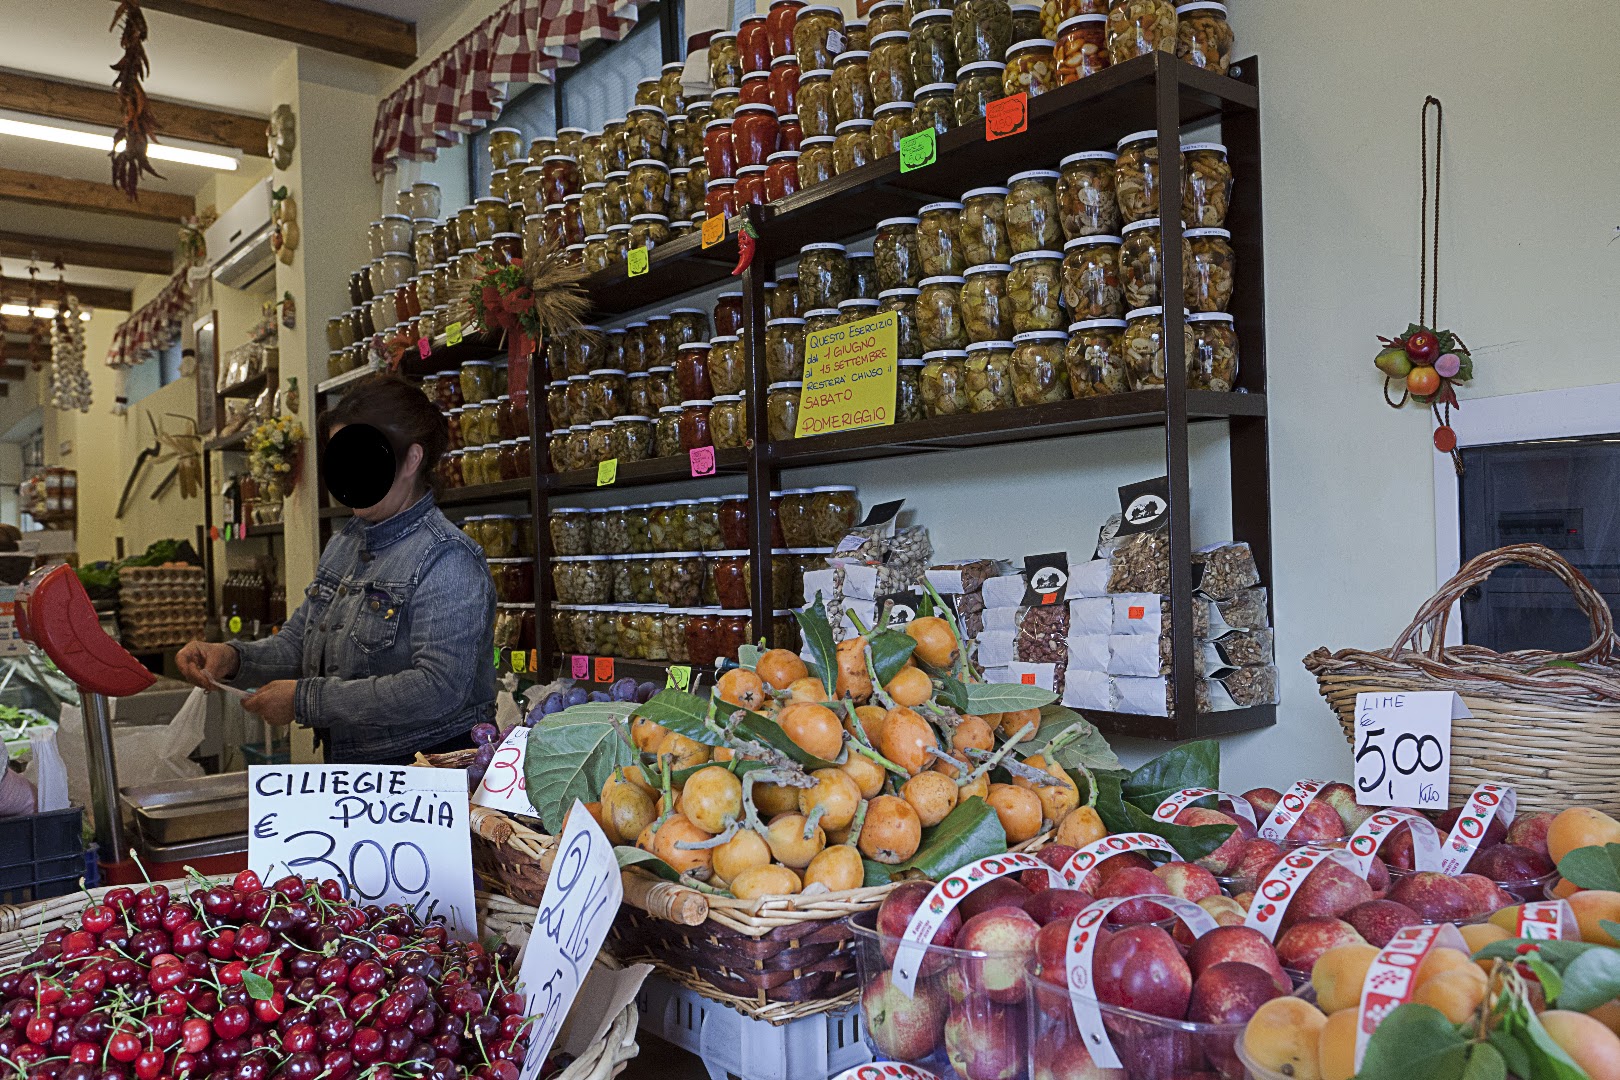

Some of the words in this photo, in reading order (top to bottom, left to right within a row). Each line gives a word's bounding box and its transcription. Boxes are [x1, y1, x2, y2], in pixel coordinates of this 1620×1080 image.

[810, 332, 845, 349] QUESTO
[849, 318, 893, 338] ESERCIZIO
[824, 347, 831, 359] 1
[834, 336, 876, 357] GIUGNO
[805, 368, 812, 378] al
[820, 364, 831, 374] 15
[834, 348, 888, 371] SETTEMBRE
[851, 368, 883, 382] CHIUSO
[804, 389, 853, 409] SABATO
[802, 407, 886, 432] POMERIGGIO
[1363, 695, 1405, 711] LIME
[1356, 728, 1443, 800] 5,00
[255, 771, 406, 796] CILIEGIE
[329, 794, 454, 828] PUGLIA
[254, 813, 278, 838] €
